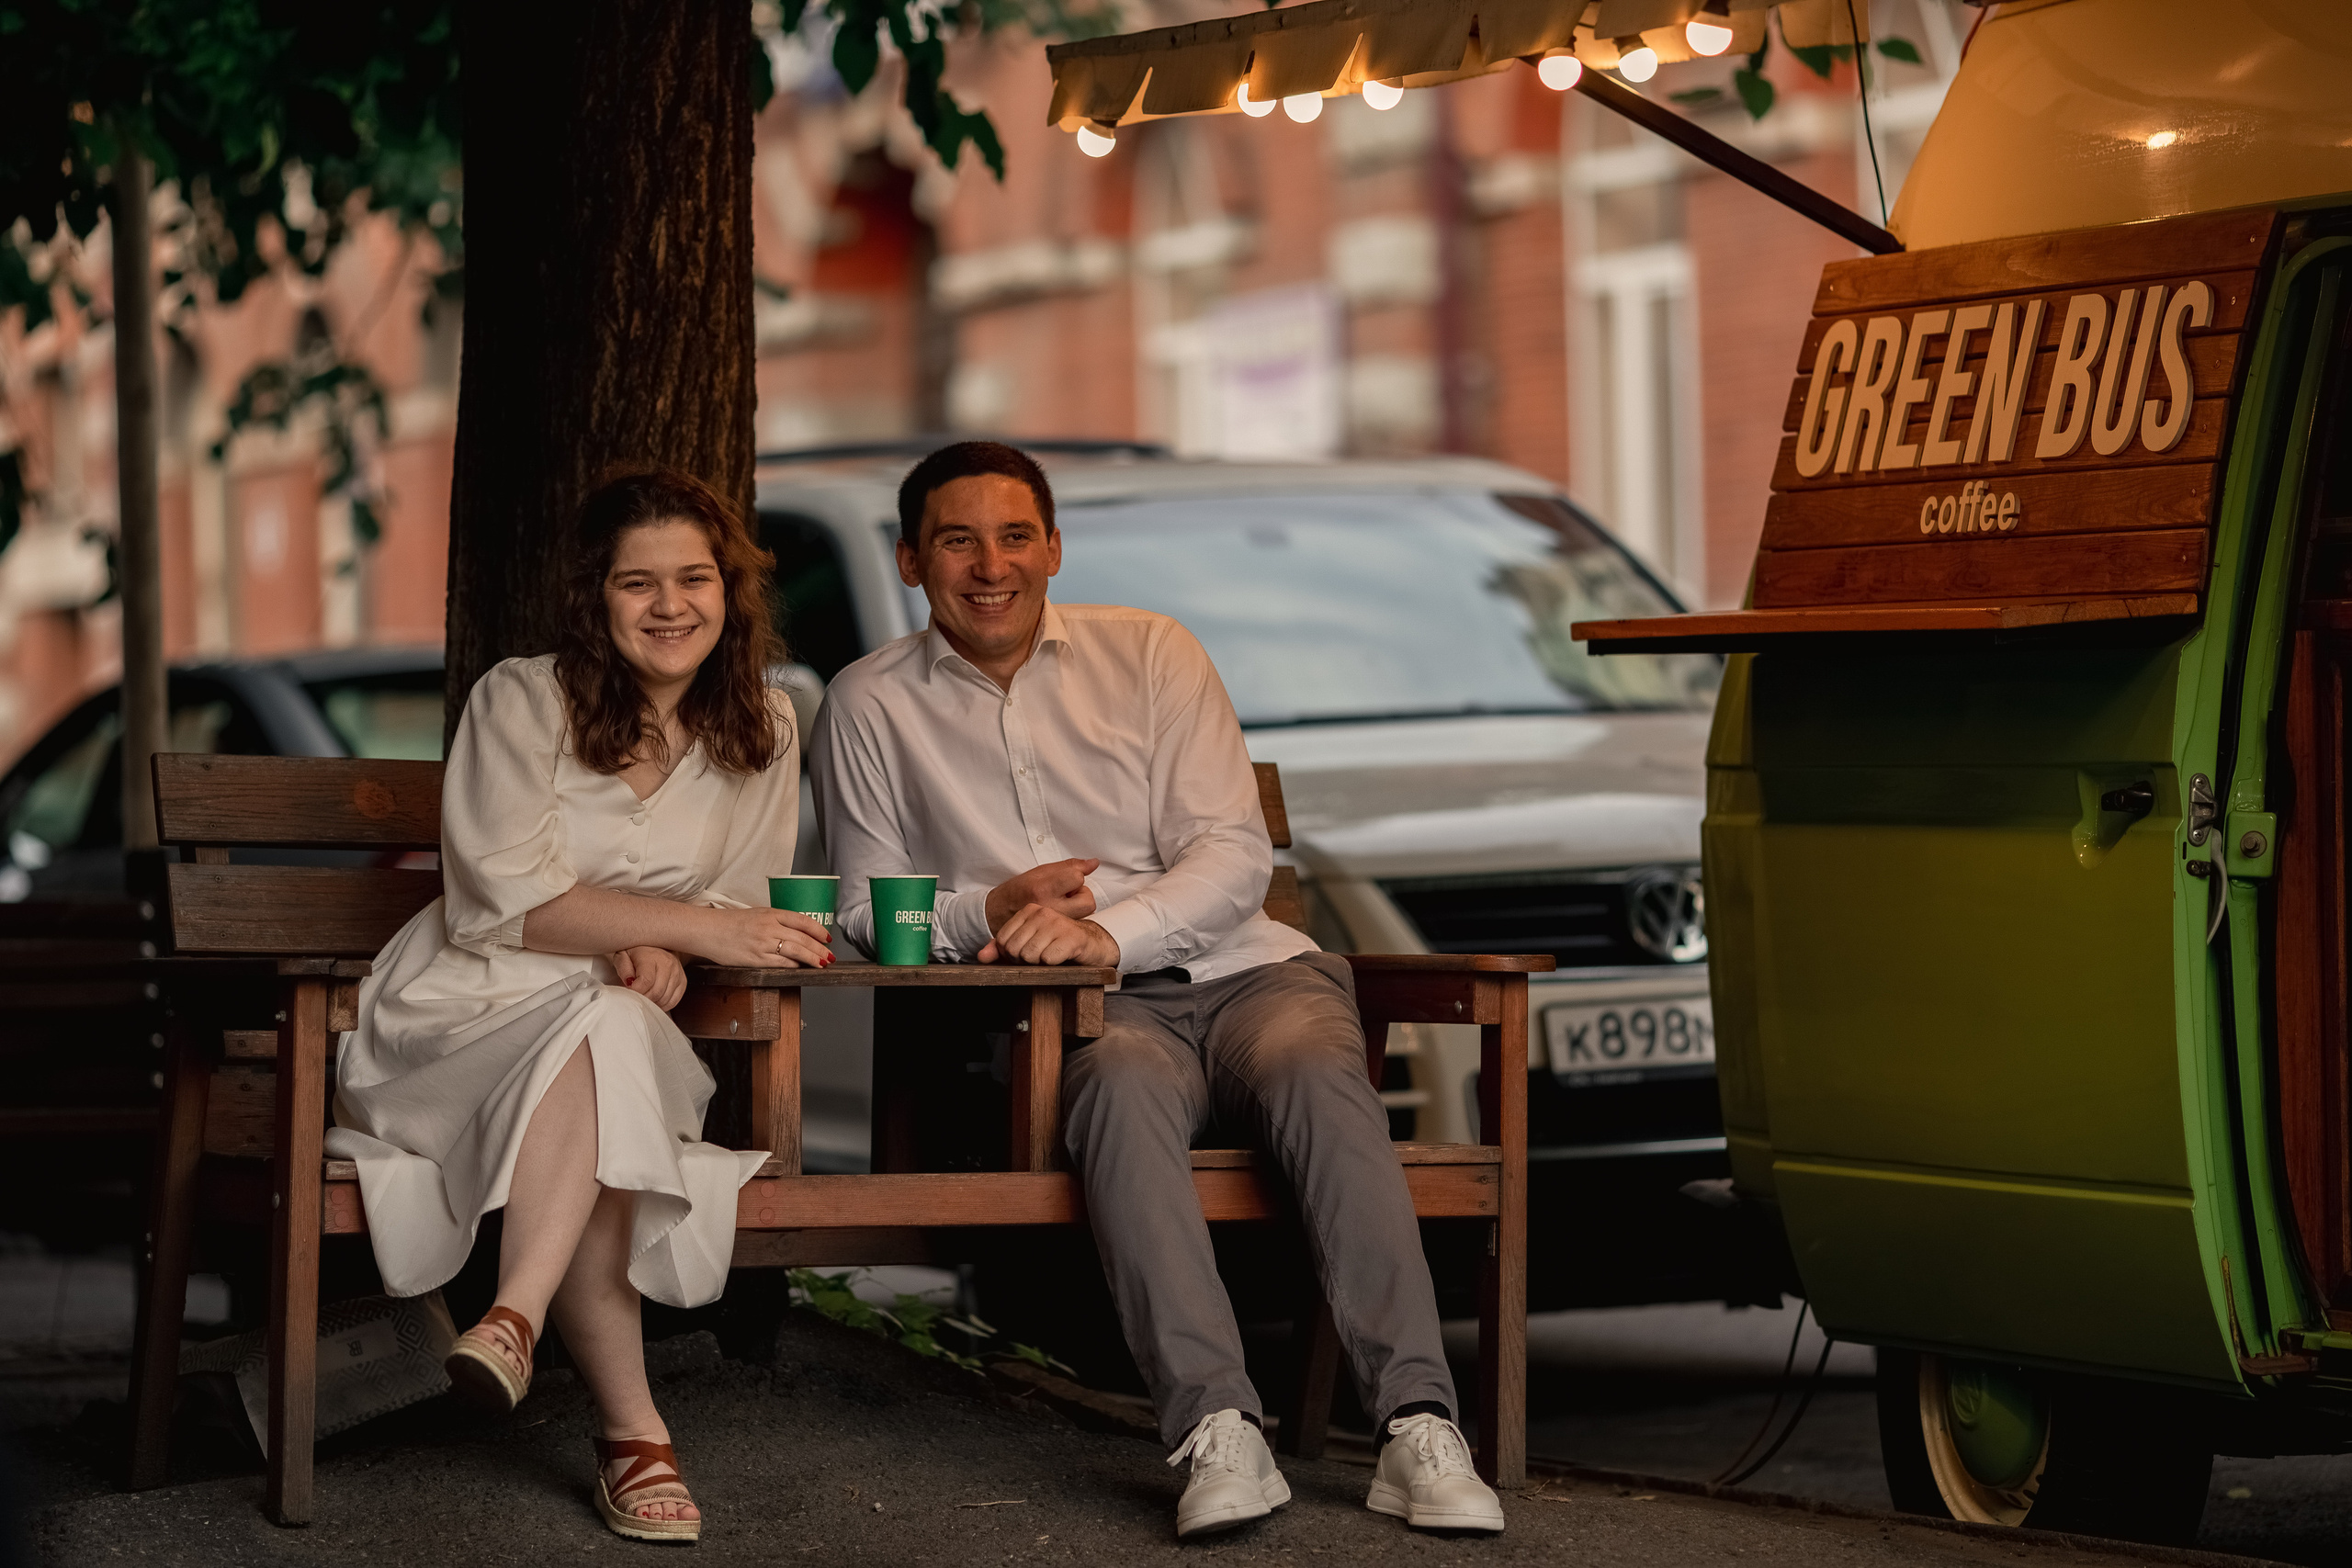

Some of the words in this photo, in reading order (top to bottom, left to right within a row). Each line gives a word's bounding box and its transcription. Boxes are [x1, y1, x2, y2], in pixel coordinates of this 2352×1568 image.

[1795, 299, 2048, 479] GREEN
[2033, 279, 2215, 459] BUS
[1919, 480, 2021, 536] coffee
[895, 909, 926, 924] GREEN
